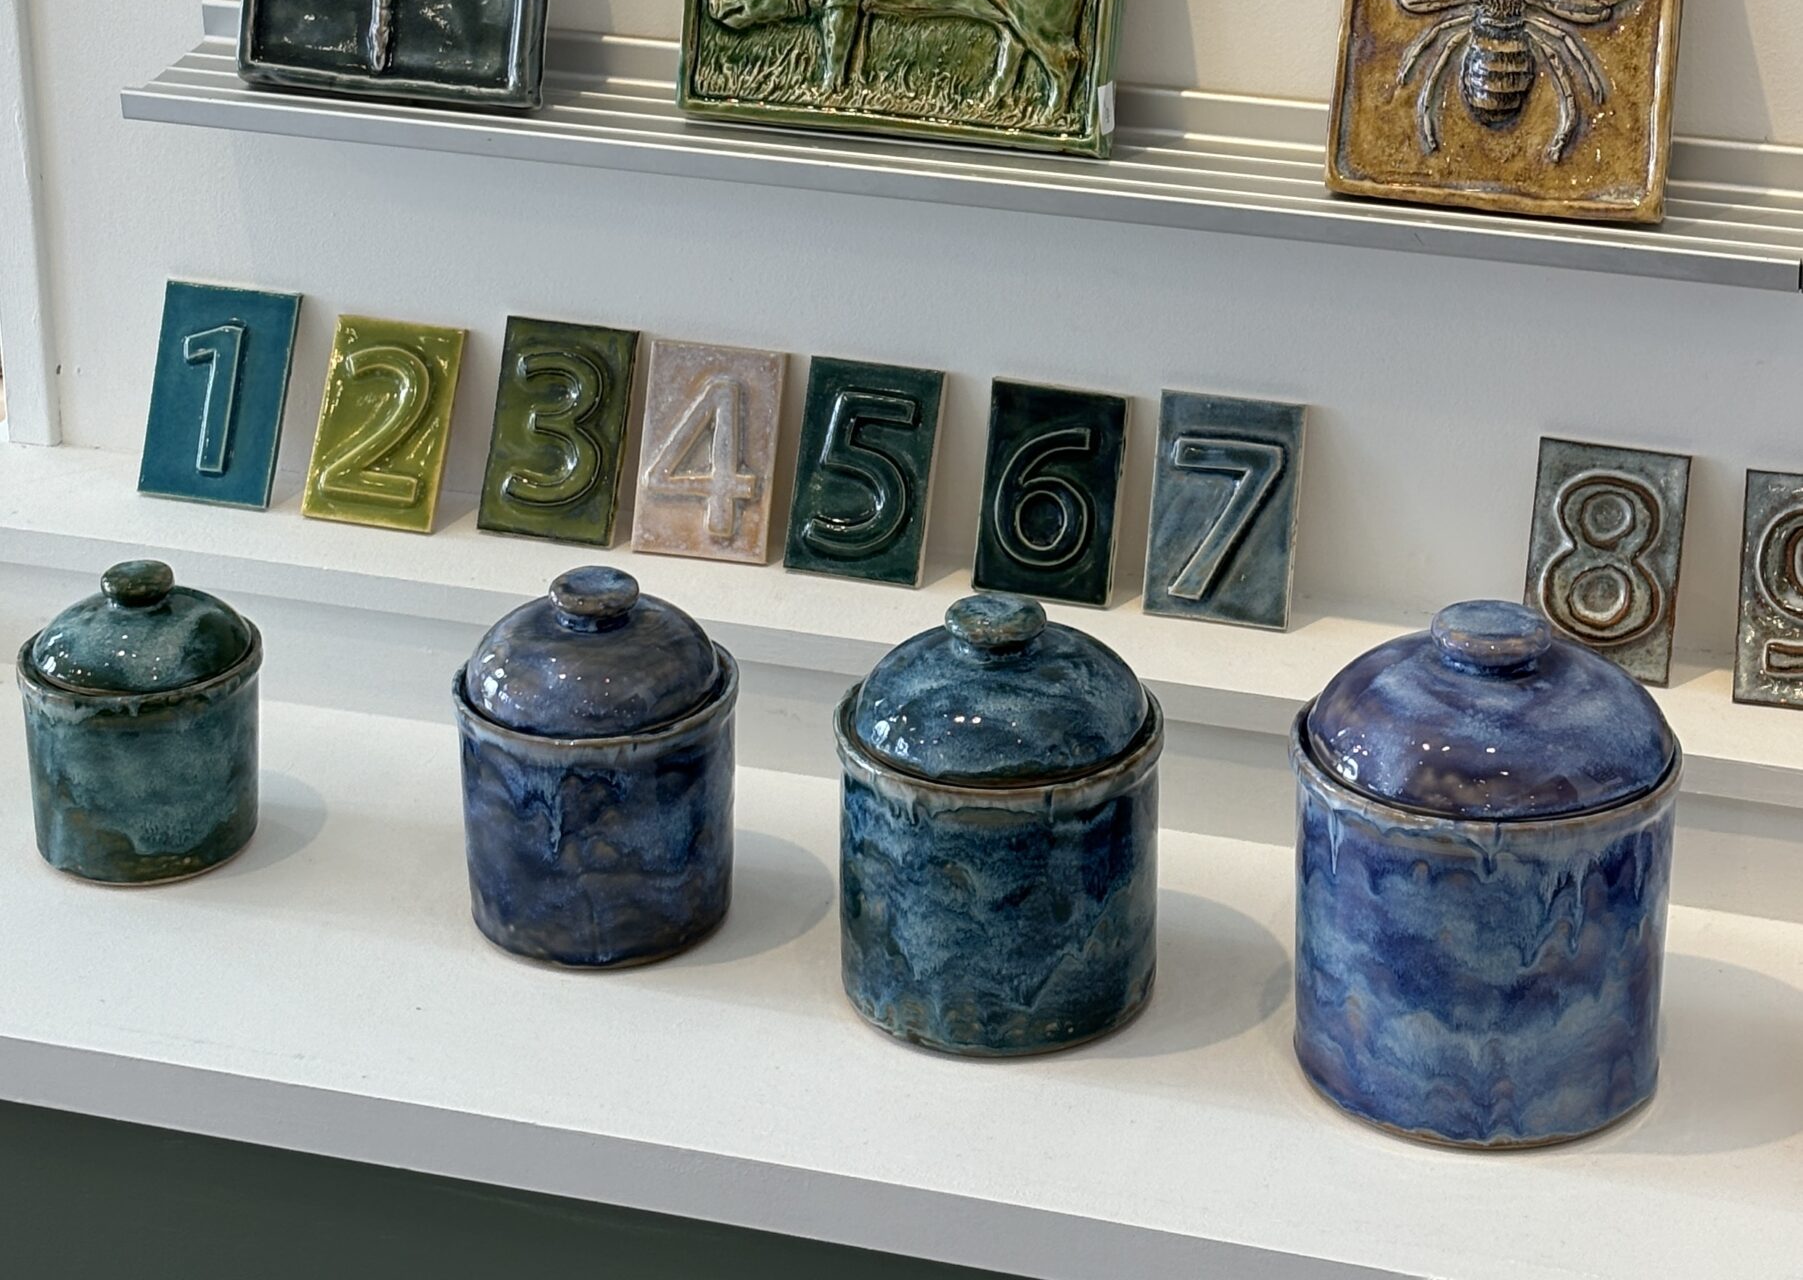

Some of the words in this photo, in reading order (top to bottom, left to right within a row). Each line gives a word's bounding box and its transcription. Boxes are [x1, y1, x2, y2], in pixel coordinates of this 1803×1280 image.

[184, 322, 243, 473] 1
[321, 346, 429, 502] 2
[502, 350, 603, 506] 3
[643, 377, 755, 536] 4
[804, 390, 916, 551] 5
[995, 427, 1089, 567] 6
[1168, 437, 1284, 600] 7
[1540, 471, 1661, 645] 8
